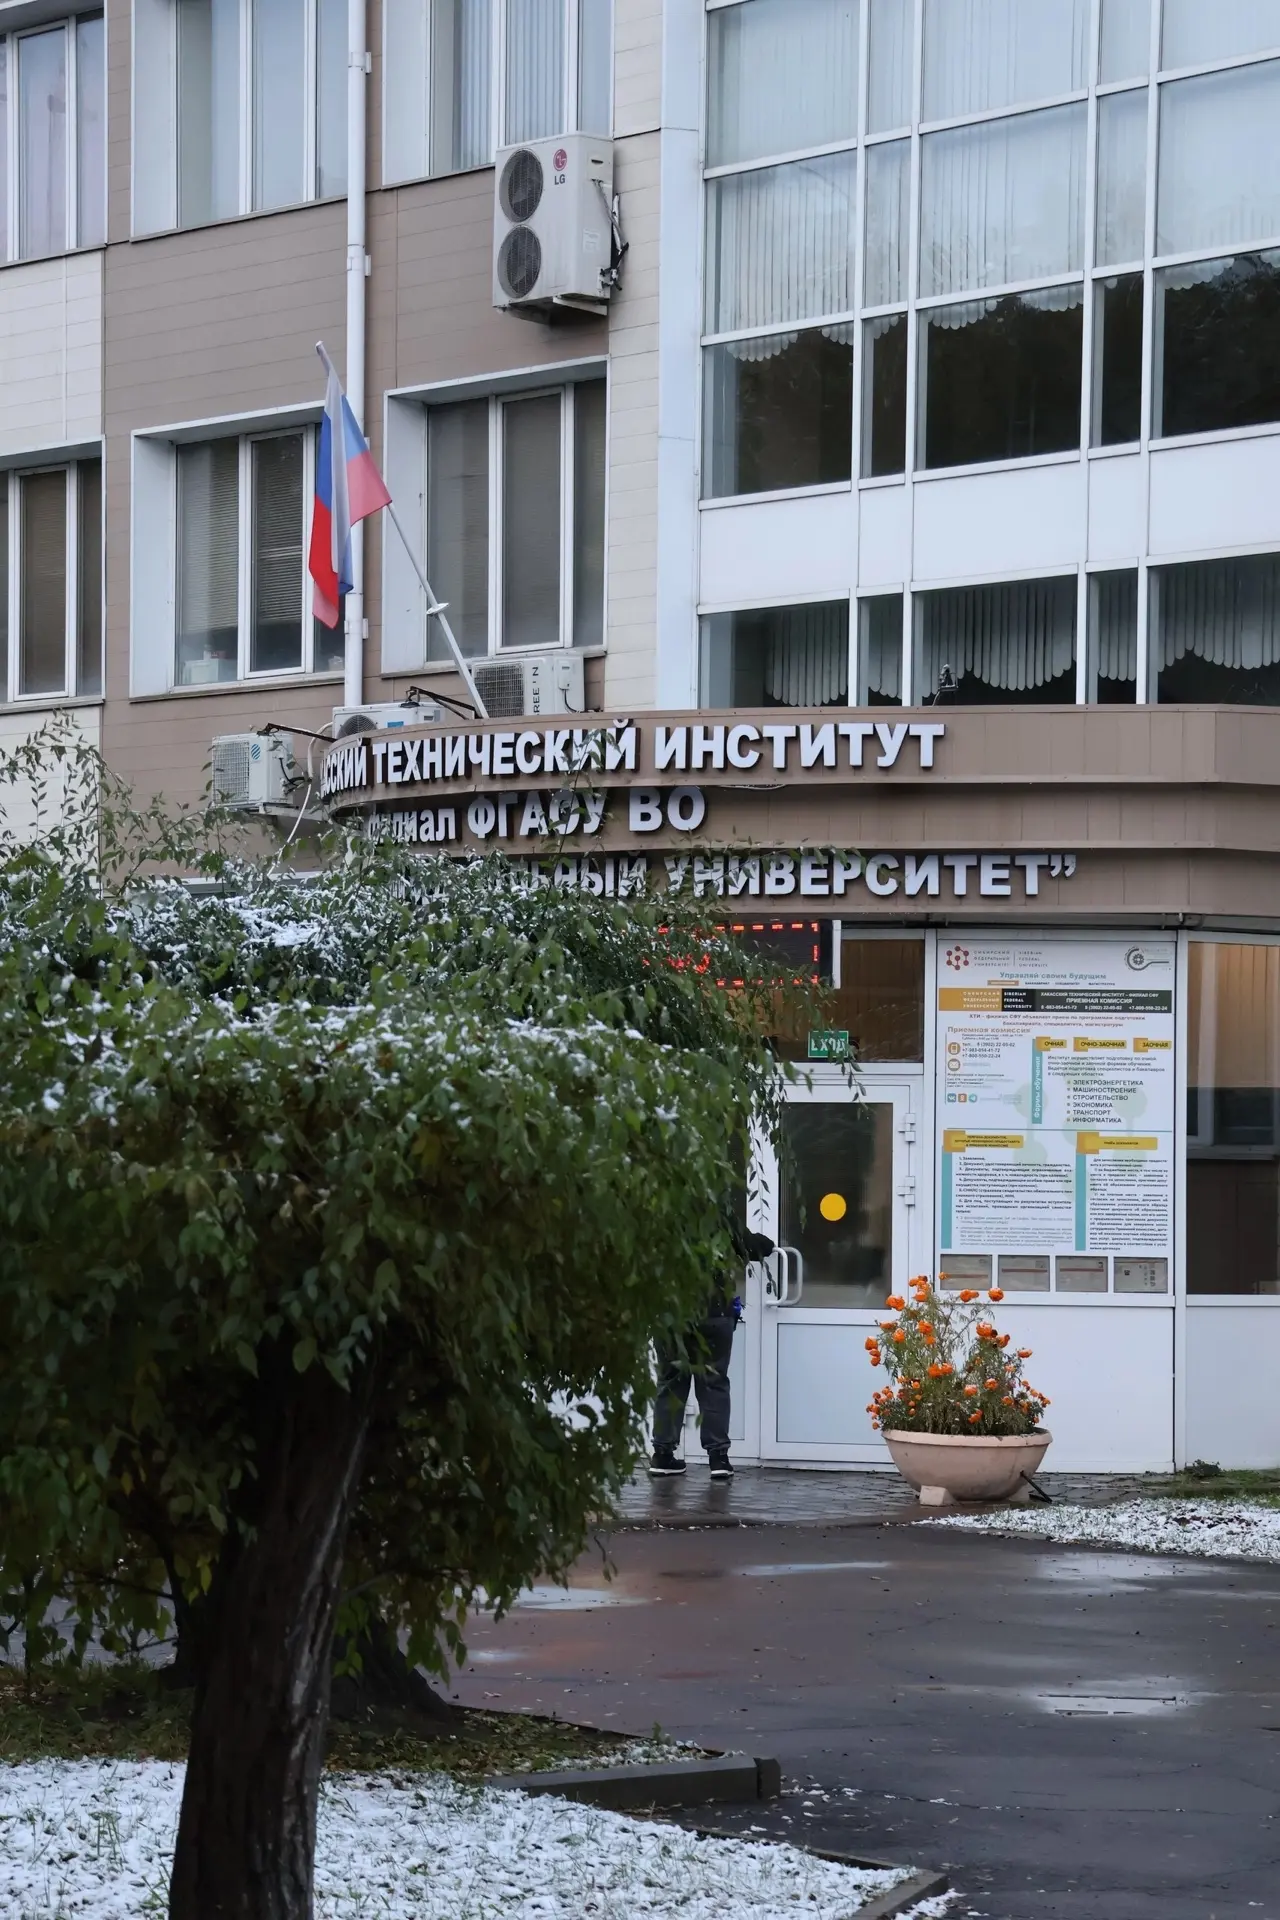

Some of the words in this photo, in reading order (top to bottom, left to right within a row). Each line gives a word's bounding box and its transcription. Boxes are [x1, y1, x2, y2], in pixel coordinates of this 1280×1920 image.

[554, 174, 566, 185] LG
[372, 718, 637, 783] ТЕХНИЧЕСКИЙ
[655, 722, 945, 769] ИНСТИТУТ
[629, 785, 706, 832] ВО
[999, 971, 1039, 979] Управляй
[947, 1026, 989, 1034] Приемная
